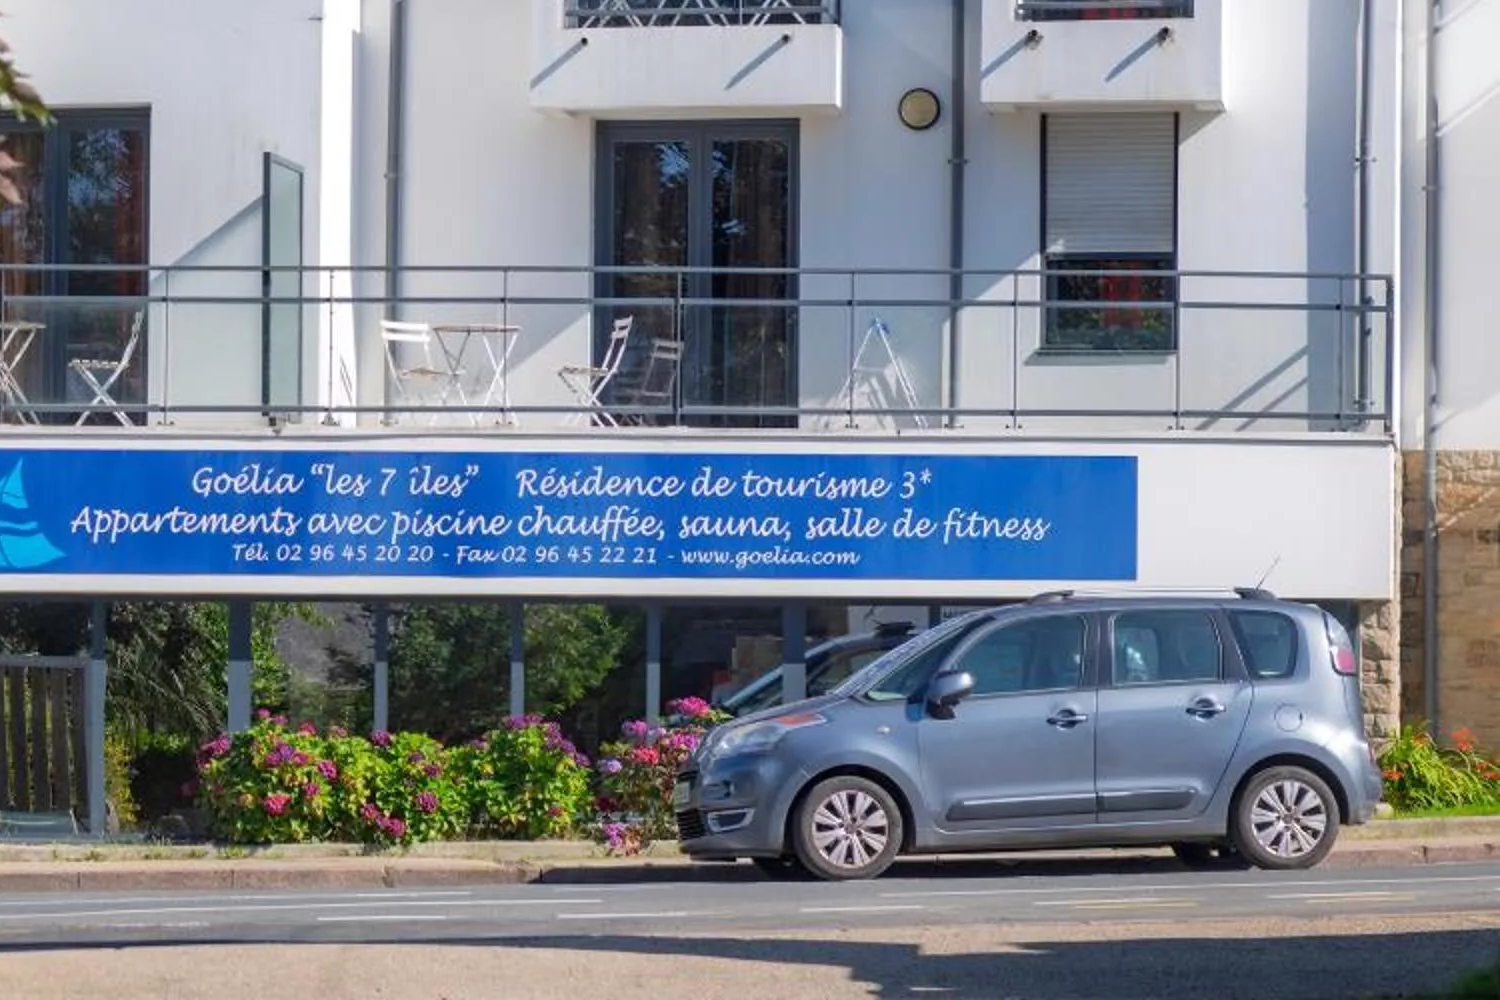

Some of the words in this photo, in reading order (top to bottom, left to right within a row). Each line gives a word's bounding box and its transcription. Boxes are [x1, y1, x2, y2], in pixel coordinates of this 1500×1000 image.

[192, 464, 304, 497] Goélia
[381, 468, 397, 496] 7
[516, 466, 686, 498] Résidence
[691, 466, 737, 497] de
[741, 470, 892, 500] tourisme
[70, 506, 303, 543] Appartements
[307, 513, 387, 535] avec
[391, 509, 513, 545] piscine
[517, 505, 665, 543] chauffée,
[678, 516, 791, 541] sauna,
[805, 507, 887, 540] salle
[892, 508, 938, 538] de
[943, 507, 1051, 545] fitness
[233, 543, 269, 561] Tél.
[276, 544, 302, 561] 02
[310, 544, 335, 561] 96
[342, 544, 368, 562] 45
[374, 545, 401, 562] 20
[407, 545, 434, 562] 20
[457, 545, 500, 564] Fax
[501, 545, 527, 563] 02
[535, 546, 560, 563] 96
[567, 546, 592, 563] 45
[599, 546, 625, 563] 22
[632, 547, 657, 563] 21
[681, 546, 861, 569] www.goelia.com
